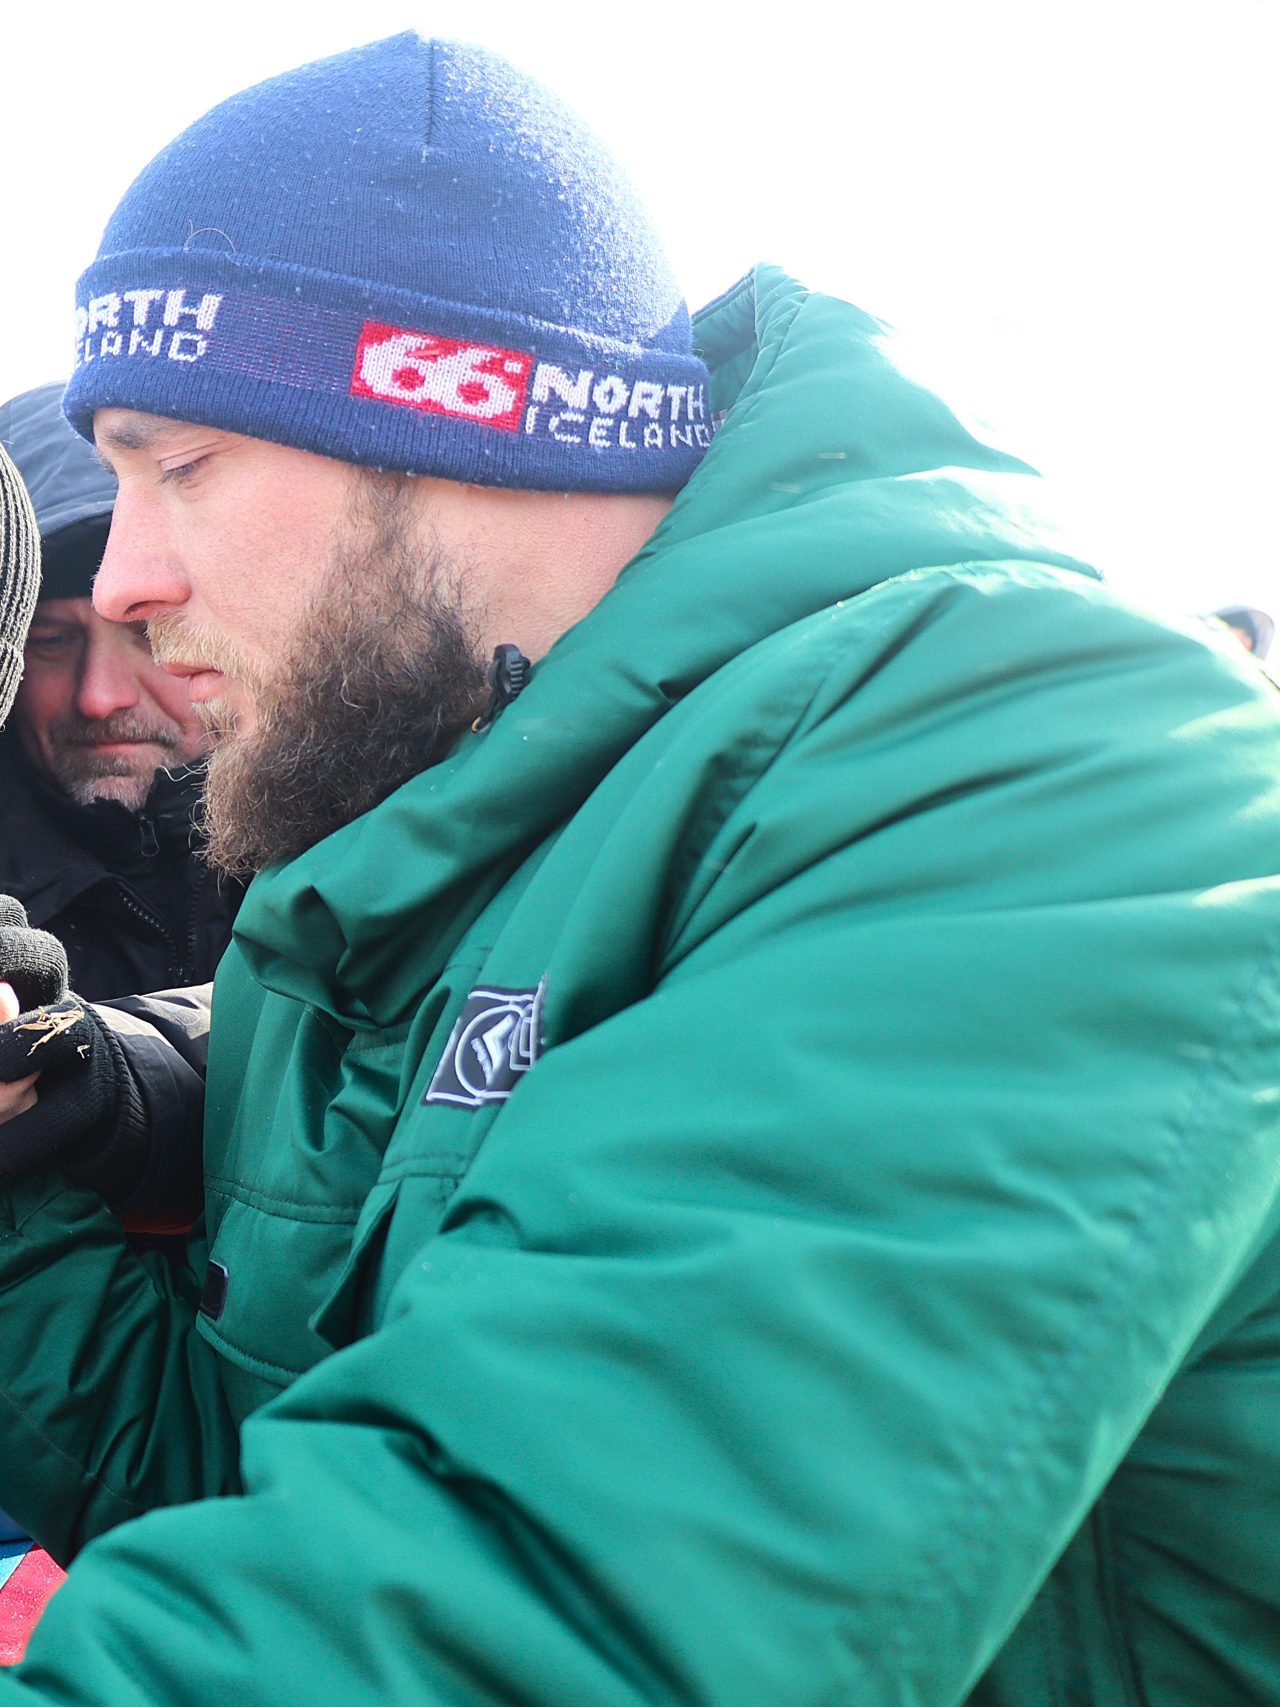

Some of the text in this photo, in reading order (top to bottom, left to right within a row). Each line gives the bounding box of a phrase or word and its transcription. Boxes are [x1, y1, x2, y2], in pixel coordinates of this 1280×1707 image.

[75, 289, 224, 342] ORTH
[75, 328, 208, 370] ELAND
[532, 362, 705, 421] NORTH
[524, 404, 711, 449] ICELAND
